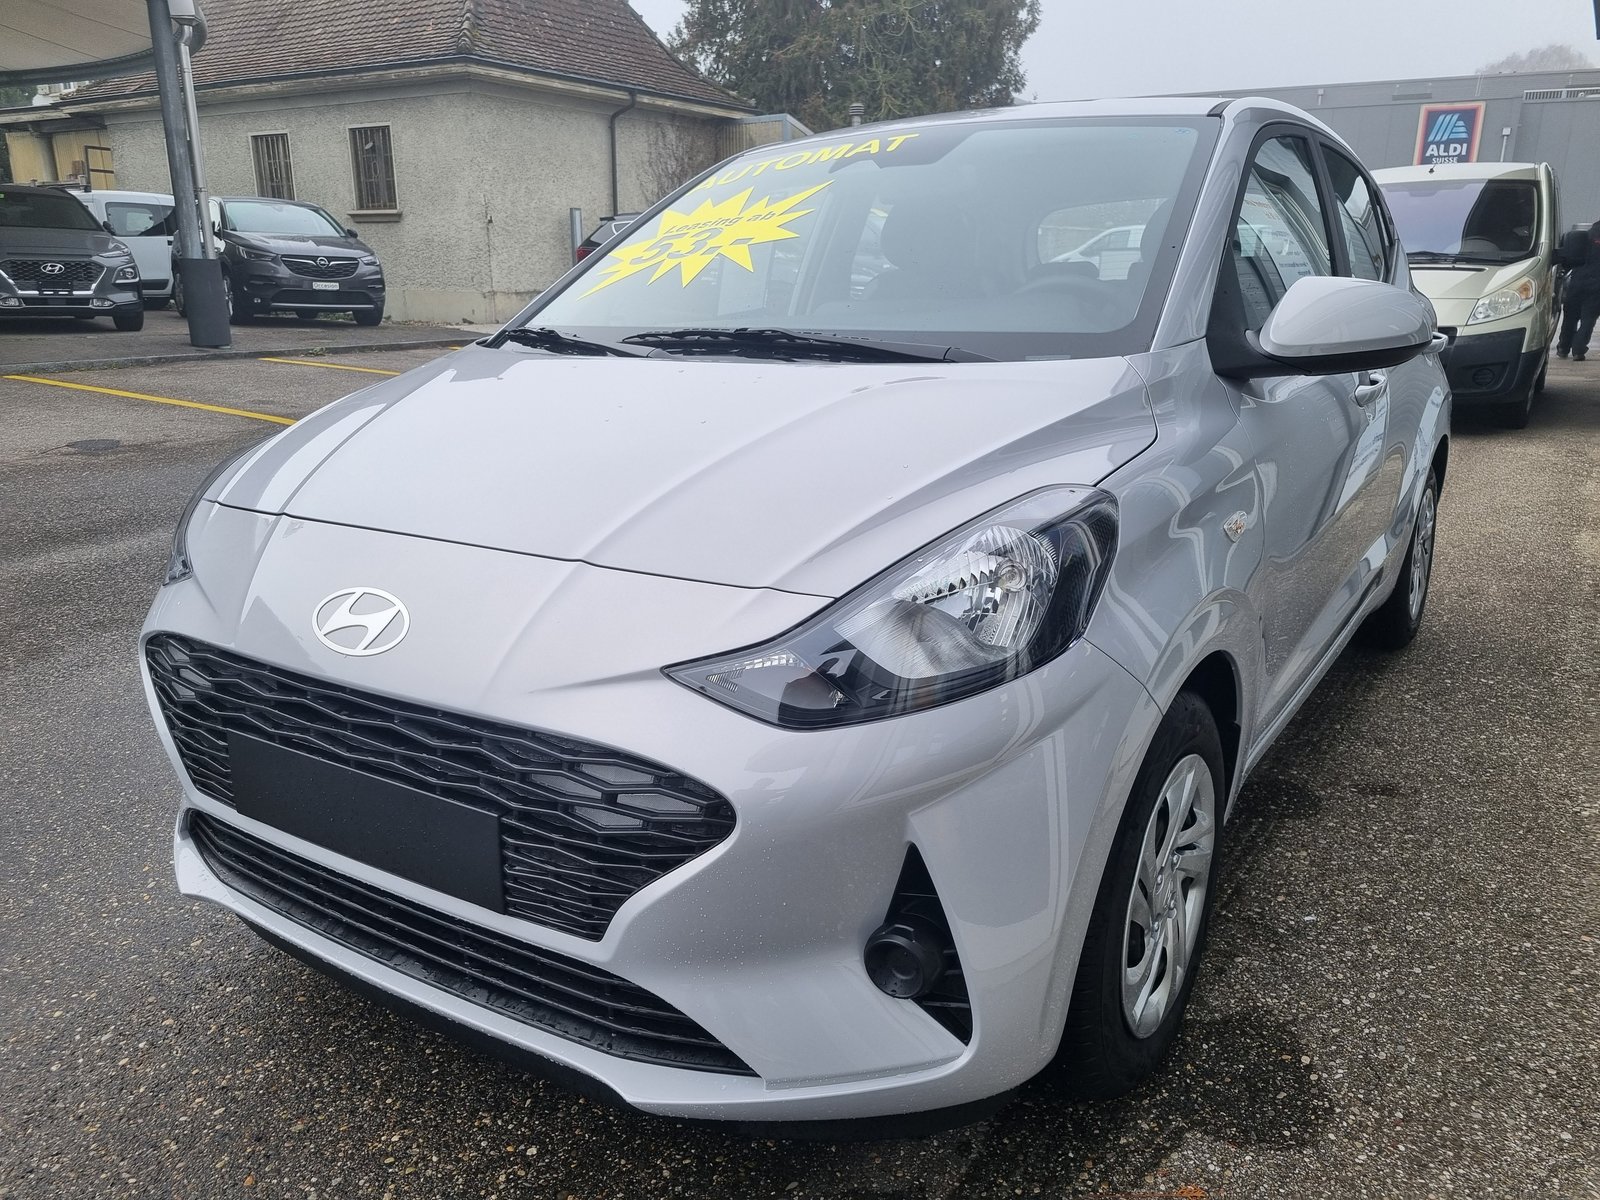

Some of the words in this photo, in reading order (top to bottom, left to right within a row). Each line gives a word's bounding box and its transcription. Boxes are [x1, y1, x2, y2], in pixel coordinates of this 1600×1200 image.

[1425, 143, 1467, 156] ALDI
[692, 133, 920, 194] AUTOMAT
[663, 216, 744, 235] Leasing
[746, 211, 776, 222] ab
